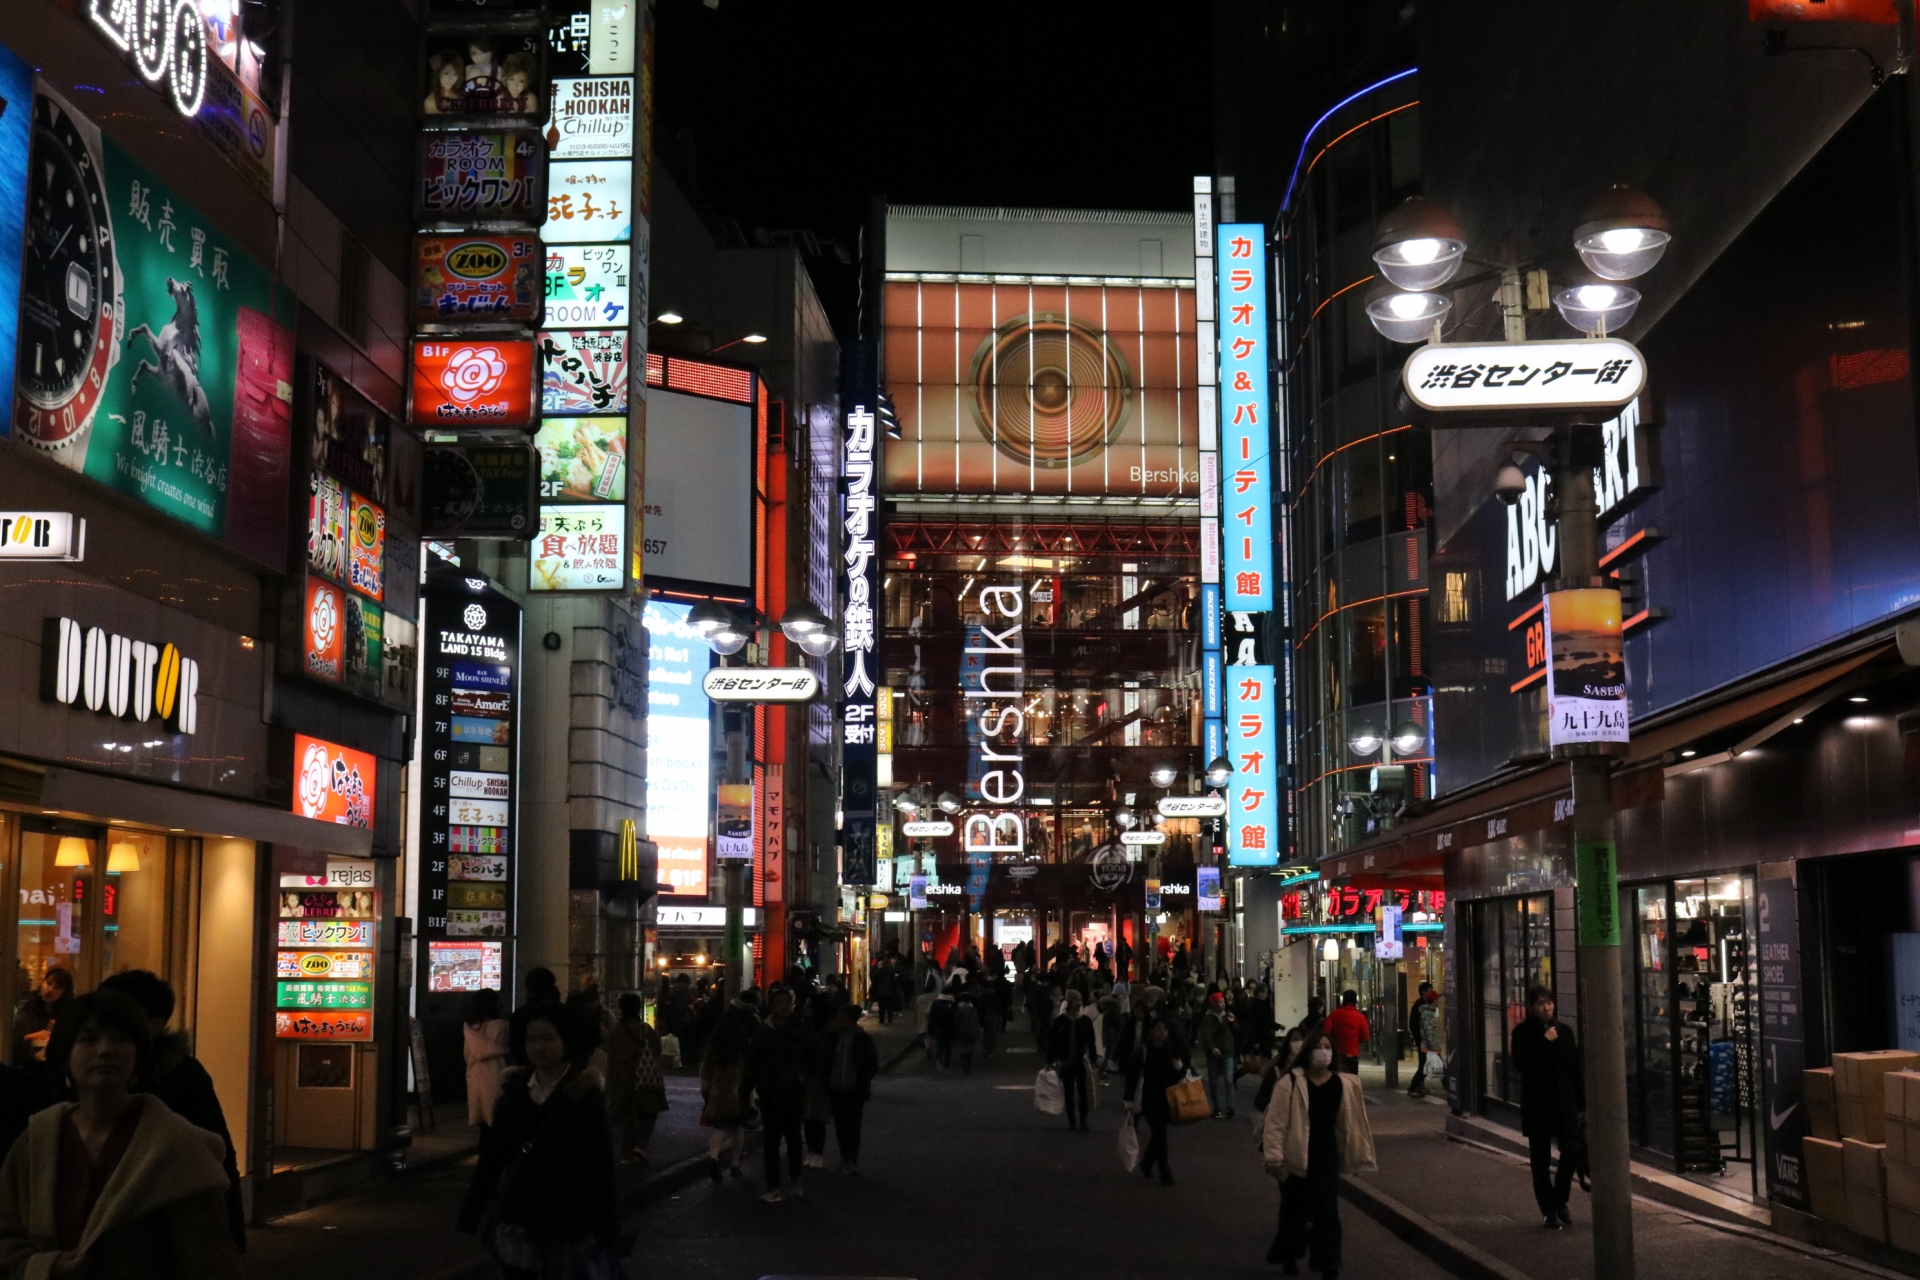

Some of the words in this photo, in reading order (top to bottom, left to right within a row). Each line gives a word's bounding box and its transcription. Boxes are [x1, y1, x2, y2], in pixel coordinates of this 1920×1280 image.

[573, 81, 631, 98] SHISHA
[565, 99, 630, 115] HOOKAH
[564, 118, 624, 137] Chillup
[429, 140, 495, 158] カラオケ
[516, 142, 535, 155] 4F
[447, 158, 505, 171] ROOM
[129, 179, 229, 290] 販売買取
[512, 242, 533, 257] 3F
[456, 254, 501, 269] ZOO
[446, 283, 478, 293] フリー
[480, 283, 505, 292] セット
[545, 306, 596, 322] ROOM
[593, 352, 622, 363] 渋谷店
[1420, 359, 1633, 389] 渋谷センター街
[436, 402, 507, 420] はなまるうどん
[542, 395, 566, 411] 2F
[1229, 236, 1262, 597] カラオケ&パーティー館
[191, 449, 228, 492] 渋谷店
[1130, 466, 1199, 483] Bershka
[540, 481, 564, 497] 2F
[360, 516, 375, 538] ZOO
[555, 517, 603, 534] 天ぷら
[540, 533, 619, 559] 食べ放題
[844, 404, 875, 697] カラオケの鉄人
[573, 558, 617, 570] 飲み放題
[1207, 590, 1216, 645] SKECHERS
[440, 631, 505, 648] TAKAYAMA
[1526, 620, 1547, 669] GR
[441, 642, 468, 655] LAND
[471, 646, 482, 657] 15
[484, 647, 507, 661] Bldg.
[56, 617, 199, 735] DOUTOR
[436, 667, 449, 678] 9F
[708, 677, 811, 691] 渋谷センター街
[1208, 657, 1217, 713] SKECHERS
[1583, 683, 1625, 697] SASEBO
[435, 695, 448, 705] 8F
[474, 698, 509, 711] AmorE
[845, 704, 873, 721] 2F
[965, 585, 1024, 852] Bershka
[1561, 710, 1625, 731] 九十九島
[435, 722, 447, 732] 7F
[844, 724, 875, 744] 受付
[434, 750, 447, 760] 6F
[649, 757, 662, 767] sh
[666, 756, 703, 770] books
[1239, 678, 1266, 851] カラオケ館
[433, 777, 446, 787] 5F
[451, 776, 483, 790] Chillup
[486, 778, 507, 787] SHISHA
[647, 780, 659, 790] es
[662, 778, 696, 793] DVDs
[483, 787, 507, 796] HOOKAH
[432, 805, 446, 816] 4F
[1162, 801, 1223, 812] 渋谷センター街
[905, 825, 951, 833] 渋谷センター街
[432, 833, 445, 844] 3F
[1123, 834, 1163, 842] 渋谷センター街
[431, 861, 444, 872] 2F
[330, 866, 371, 886] rejas
[432, 889, 444, 900] 1F
[925, 884, 962, 895] ershka
[1159, 883, 1190, 895] rshka
[1759, 893, 1770, 932] 2
[428, 917, 447, 927] B1F
[1762, 944, 1790, 960] LEATHER
[278, 961, 298, 970] じゃん
[305, 961, 328, 969] ZOO
[1763, 966, 1784, 982] SHOES
[294, 1017, 364, 1035] はなまるうどん
[1776, 1153, 1799, 1184] VANS
